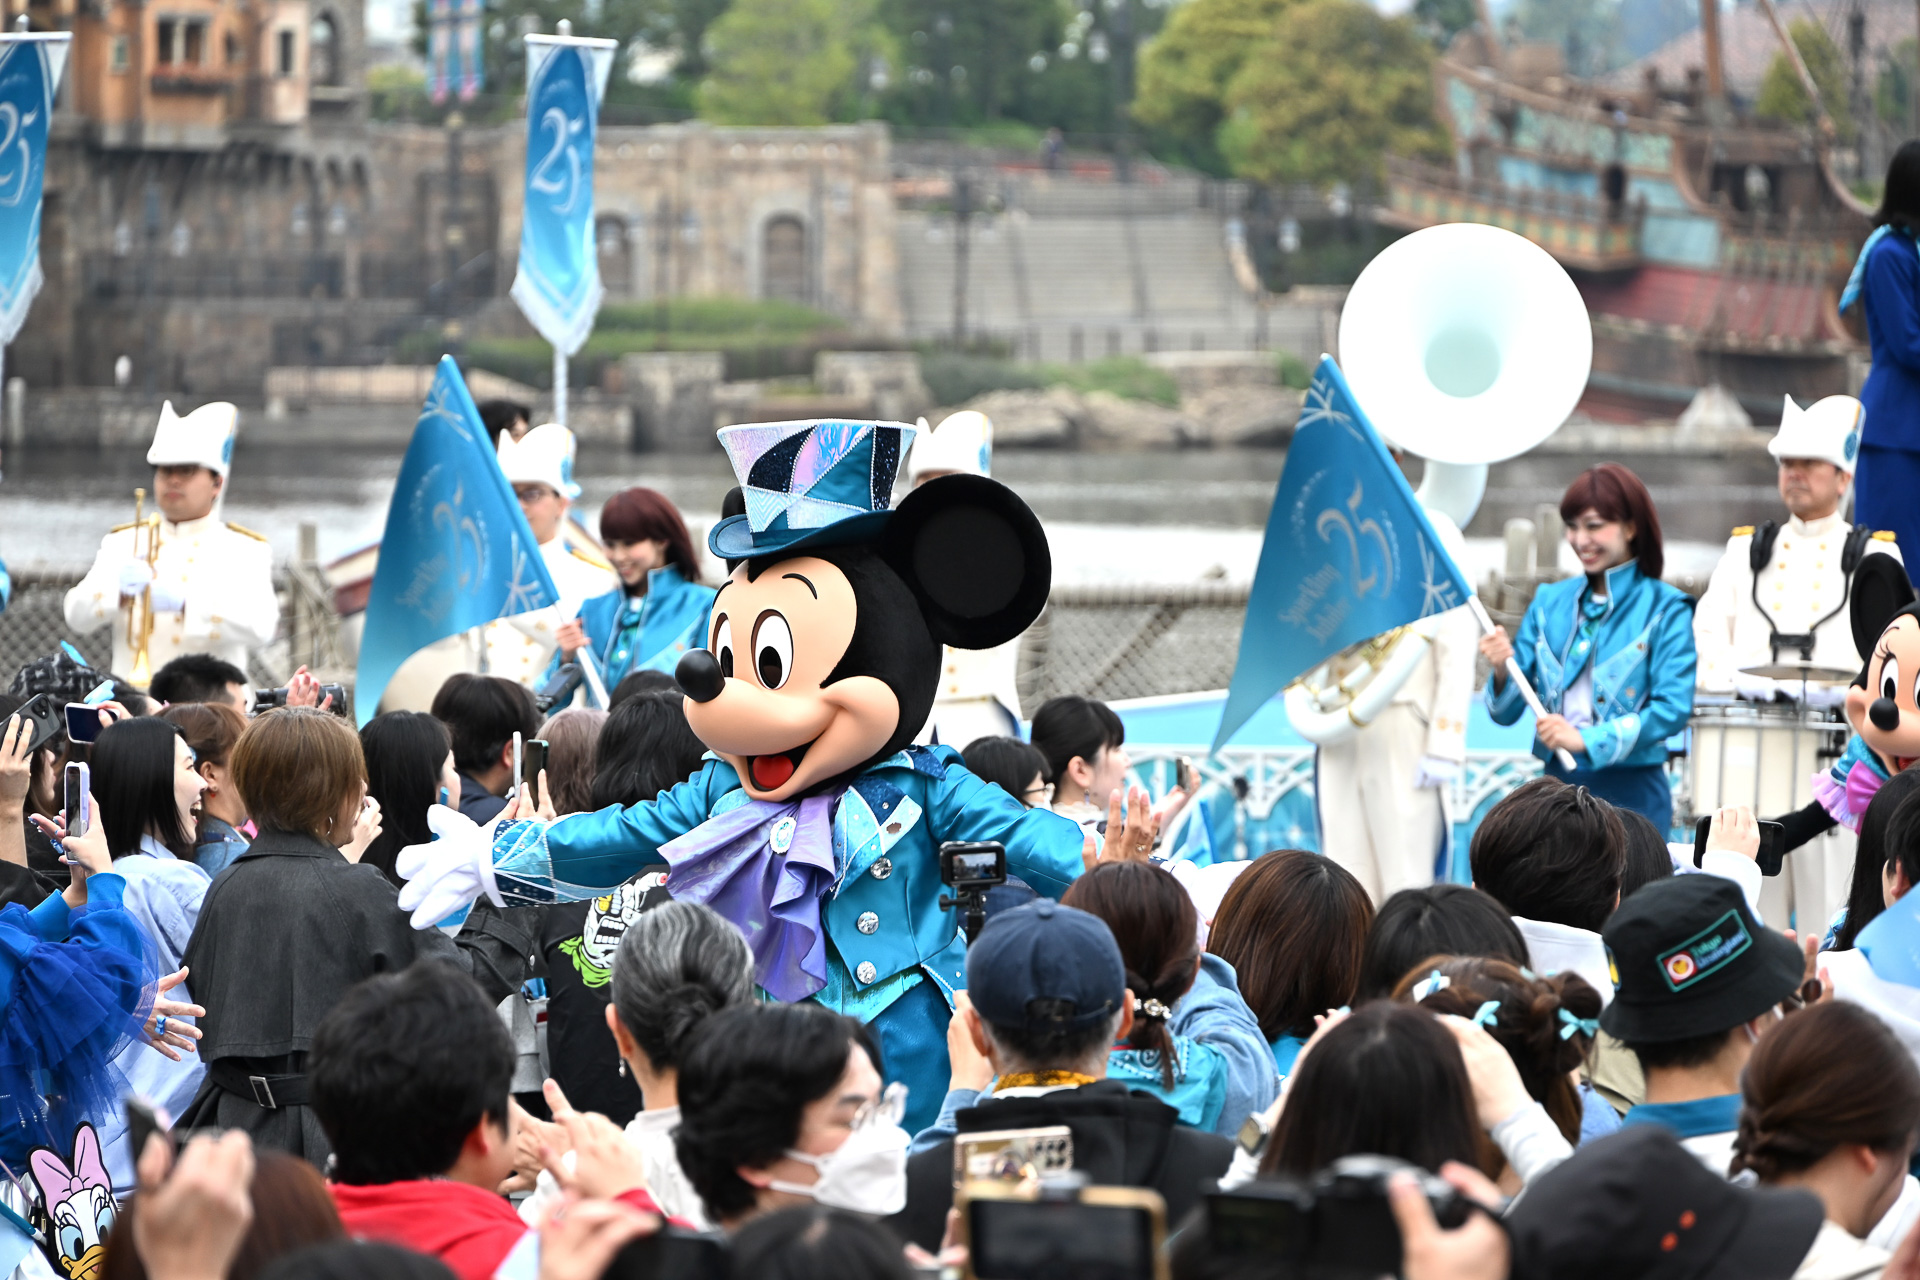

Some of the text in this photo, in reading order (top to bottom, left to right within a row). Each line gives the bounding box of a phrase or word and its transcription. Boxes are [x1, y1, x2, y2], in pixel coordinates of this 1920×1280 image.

[529, 106, 586, 216] 25
[432, 475, 483, 596] 25
[1316, 474, 1393, 600] 25
